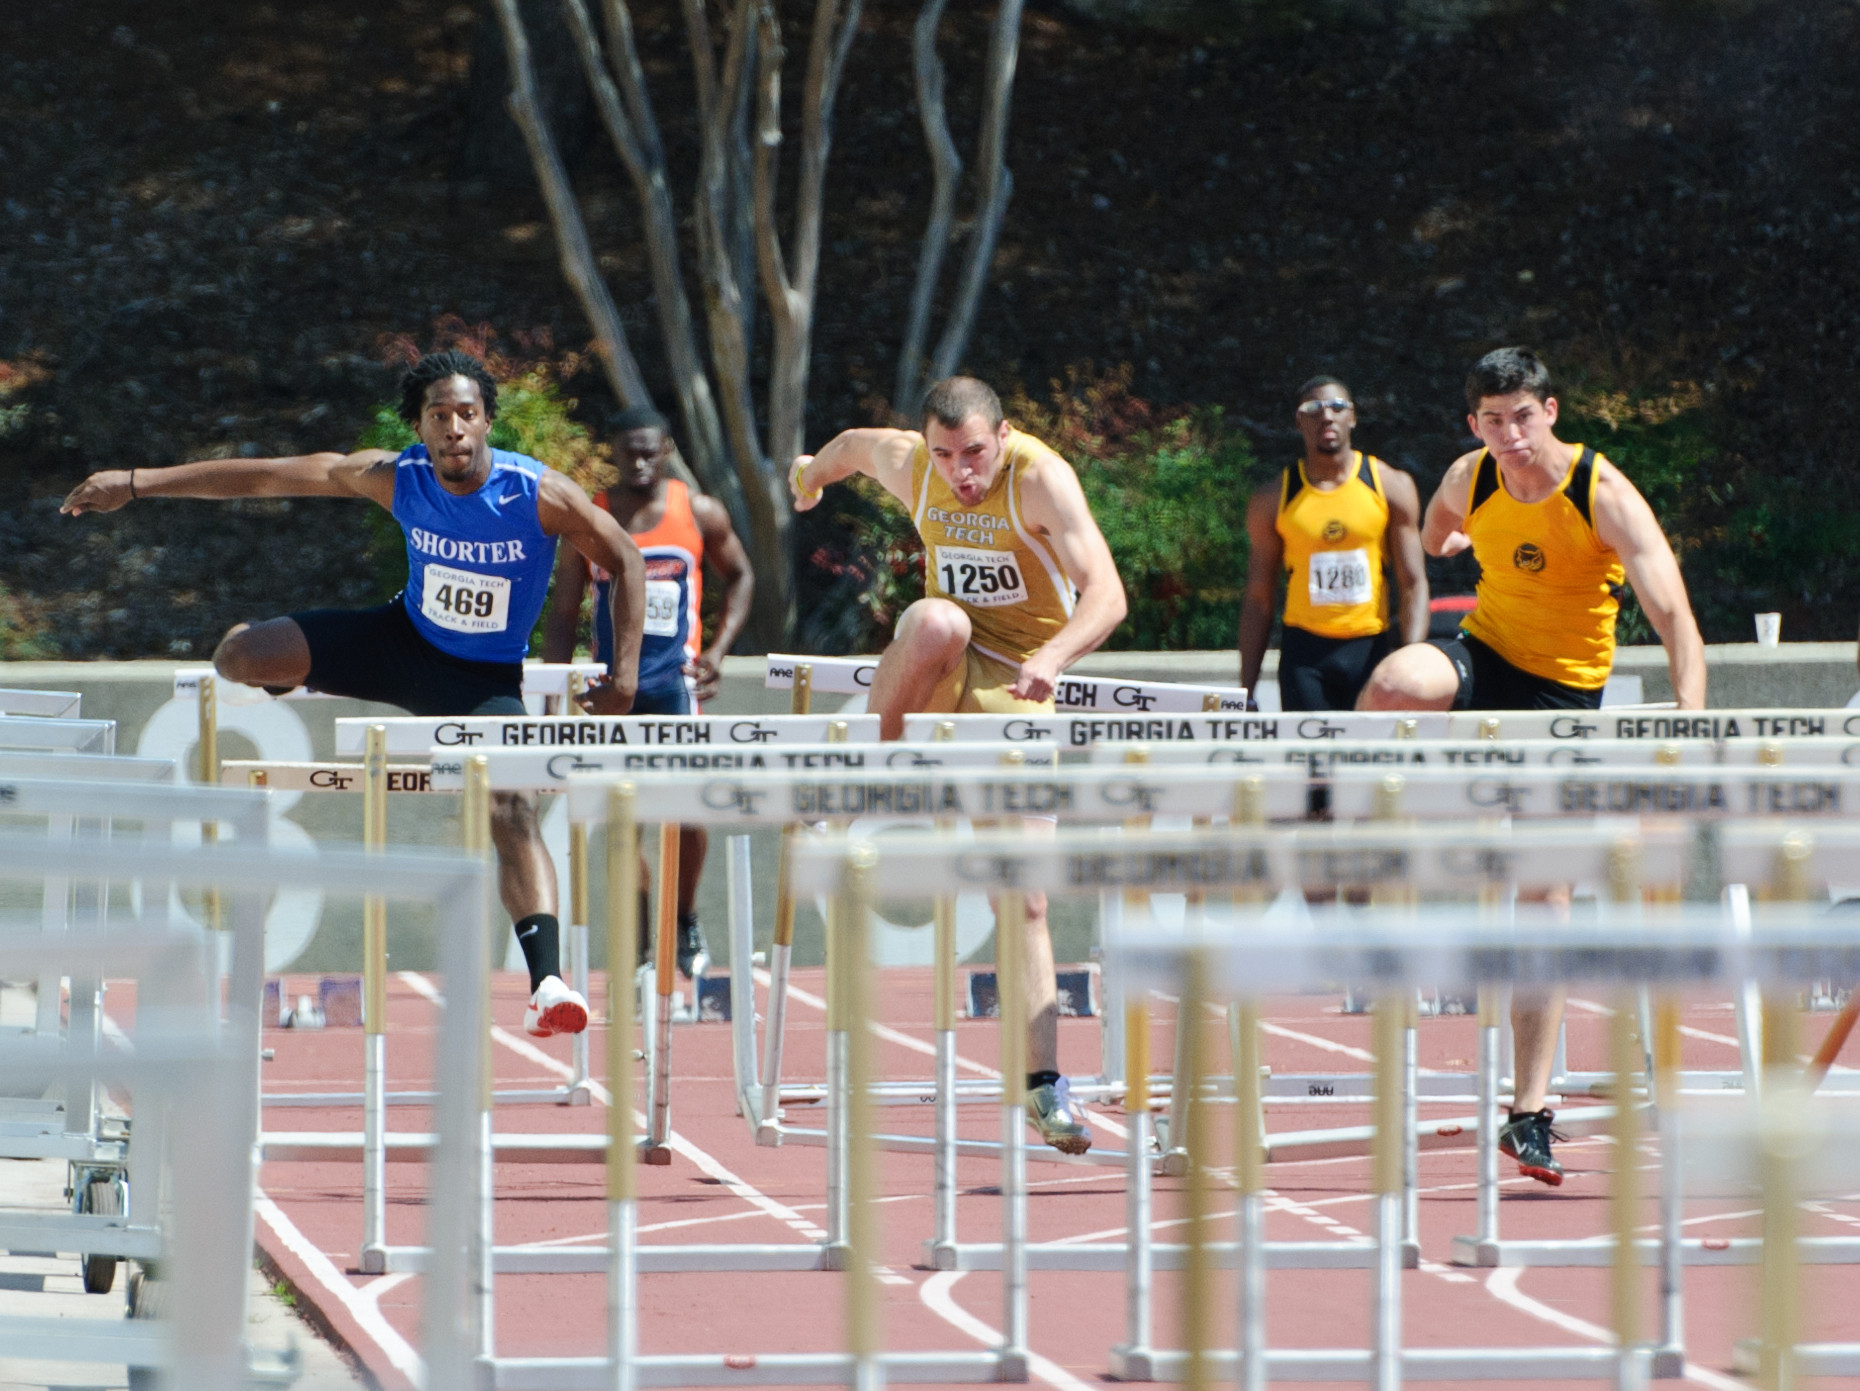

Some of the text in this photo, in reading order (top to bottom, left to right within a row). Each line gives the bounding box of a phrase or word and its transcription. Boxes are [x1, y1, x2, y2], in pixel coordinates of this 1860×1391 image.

[927, 507, 1011, 532] GEORGIA
[411, 527, 527, 564] SHORTER
[944, 525, 995, 546] TECH
[941, 551, 1010, 564] GEORGIA TECH
[429, 568, 504, 588] GEORGIA TECH
[942, 564, 1020, 595] 1250
[435, 583, 494, 618] 469
[993, 592, 1019, 603] FIELD
[428, 607, 457, 624] TRACK
[472, 620, 498, 629] FIELD
[1055, 681, 1097, 708] ECH
[502, 722, 628, 746] GEORGIA
[638, 722, 711, 744] TECH
[1070, 720, 1195, 745] GEORGIA
[1205, 719, 1278, 740] TECH
[1616, 717, 1741, 739] GEORGIA
[1752, 716, 1826, 737] TECH
[790, 780, 964, 814] GEORGIA
